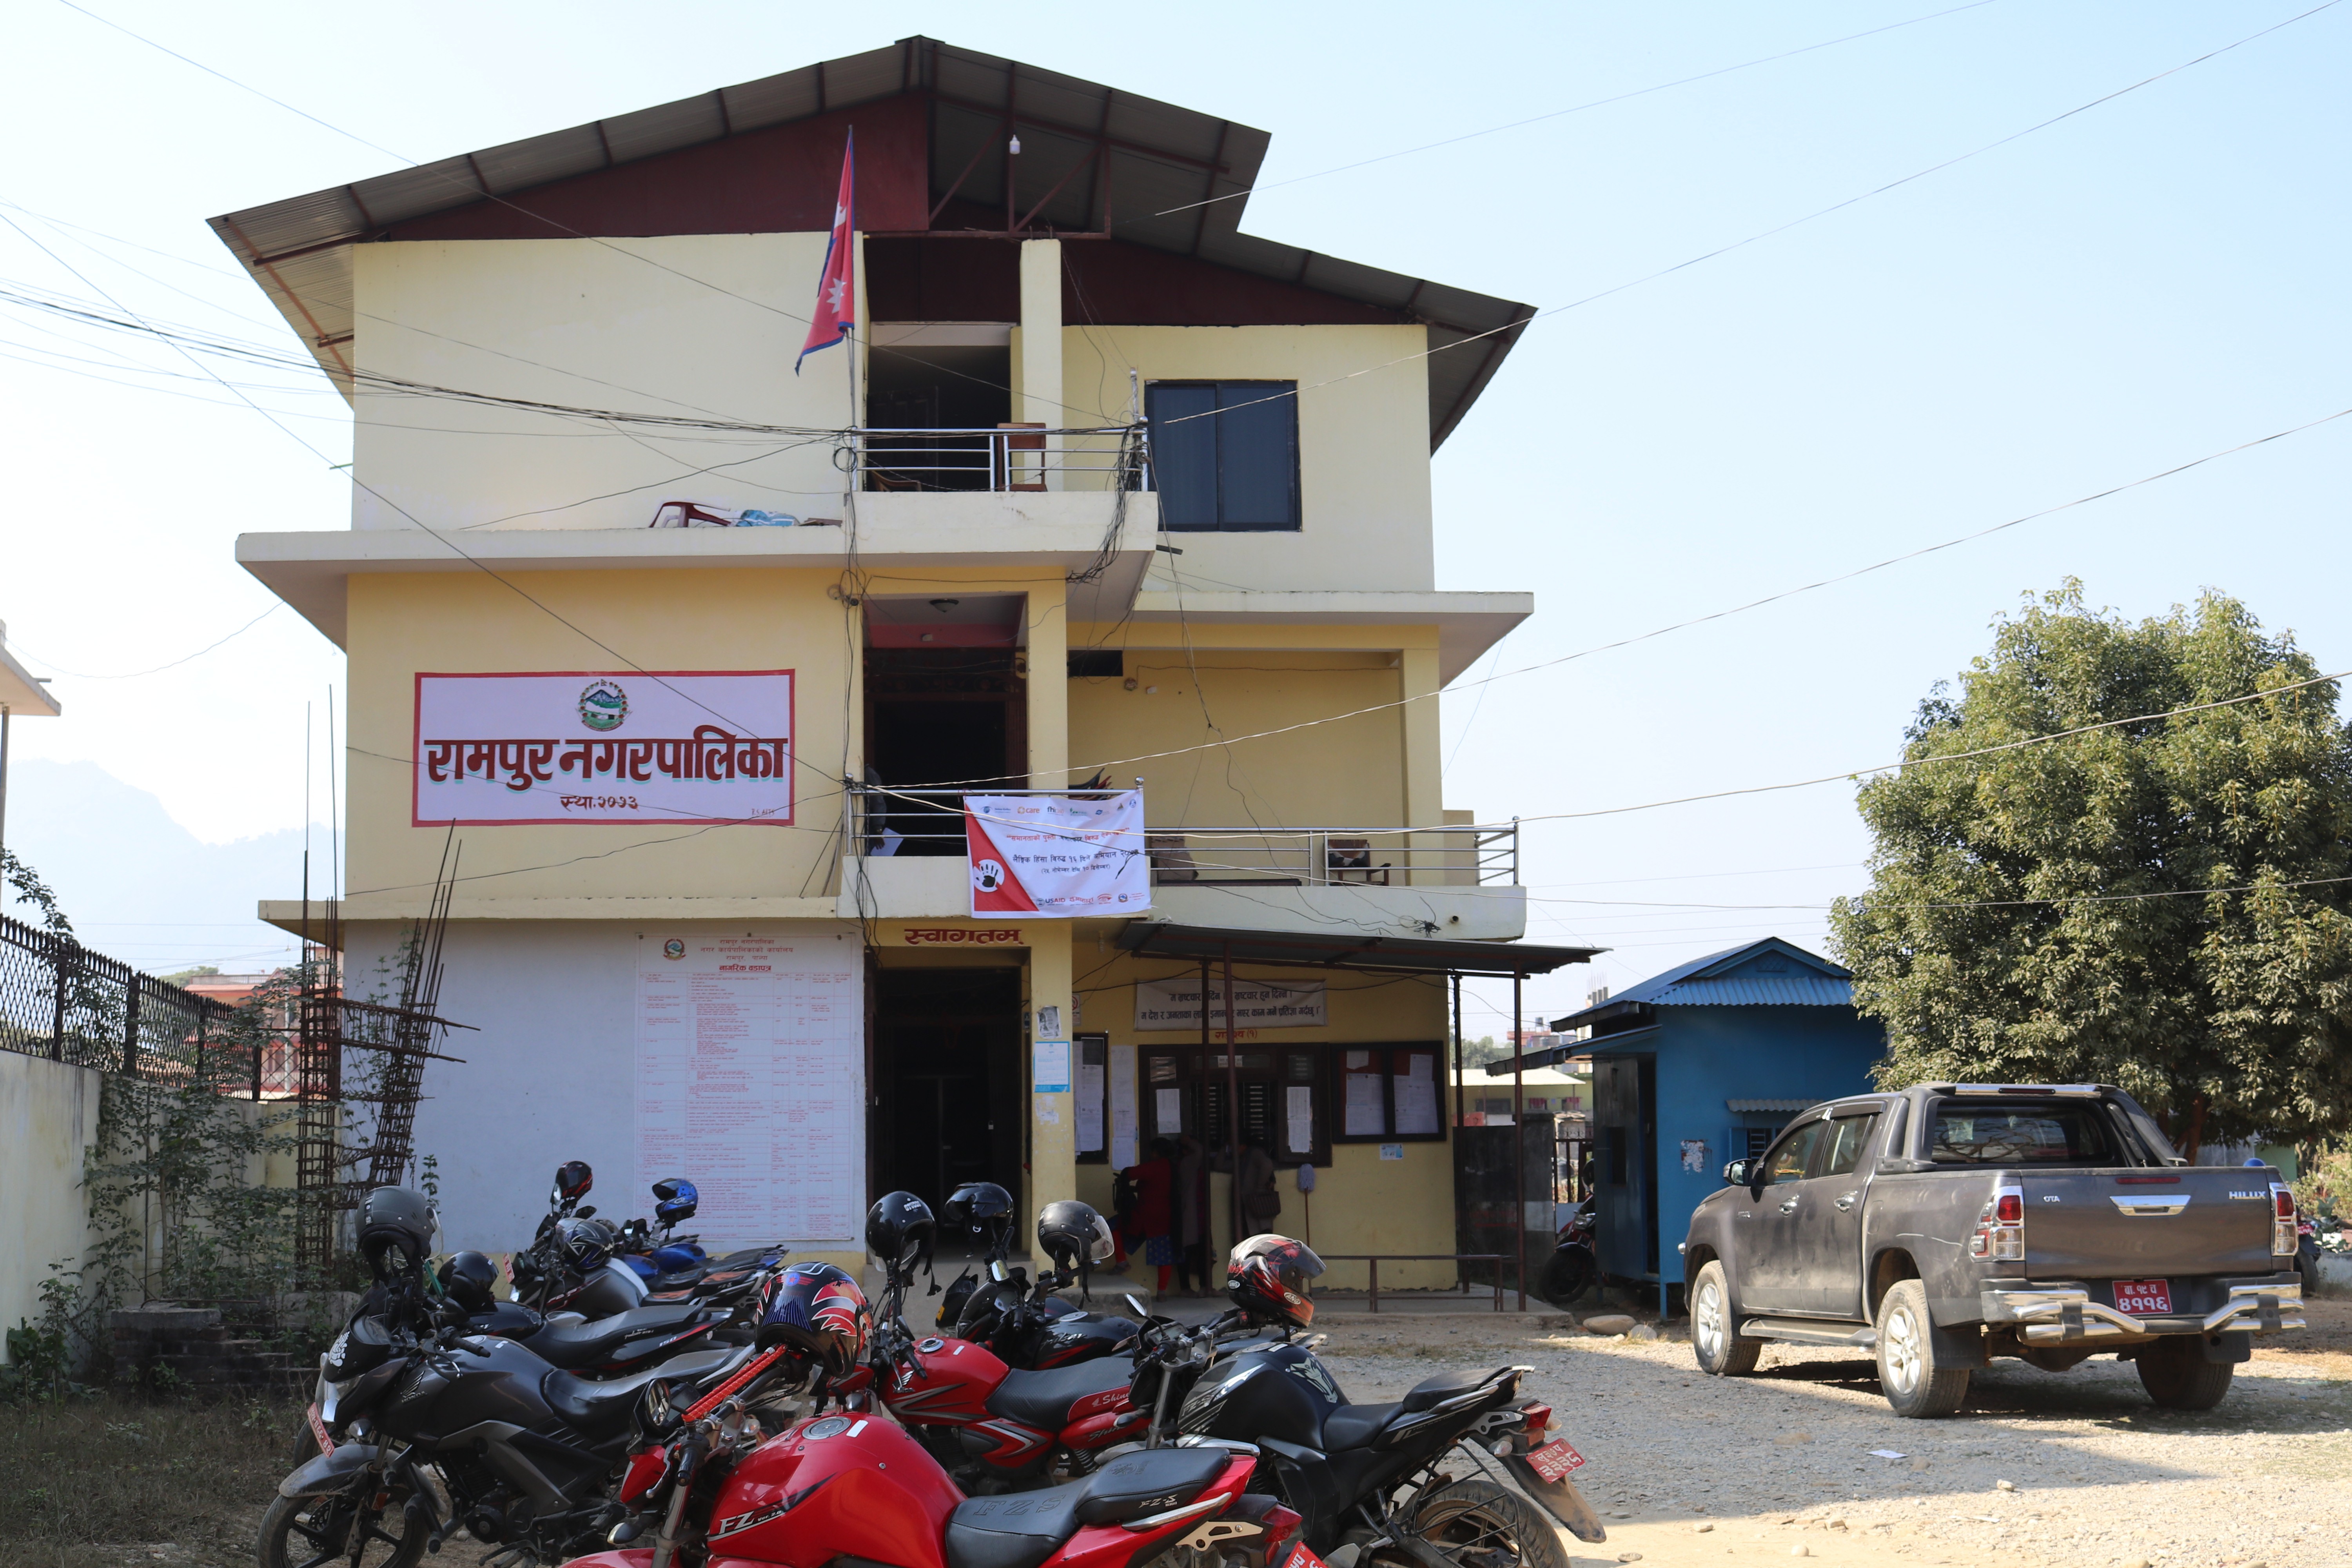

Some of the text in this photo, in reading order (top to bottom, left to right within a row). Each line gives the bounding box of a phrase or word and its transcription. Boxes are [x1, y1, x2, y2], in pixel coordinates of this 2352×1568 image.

[424, 725, 788, 791] रामपुर नगरपालिका
[1093, 851, 1117, 859] अभियान
[904, 929, 1024, 945] स्वागतम्
[2229, 1191, 2266, 1200] HILUX
[1287, 1294, 1300, 1303] ANG
[2119, 1296, 2168, 1311] ४११६
[659, 1336, 677, 1347] 150
[401, 1391, 428, 1403] HONDA
[1138, 1494, 1178, 1508] FZ-S
[719, 1511, 755, 1535] FZ
